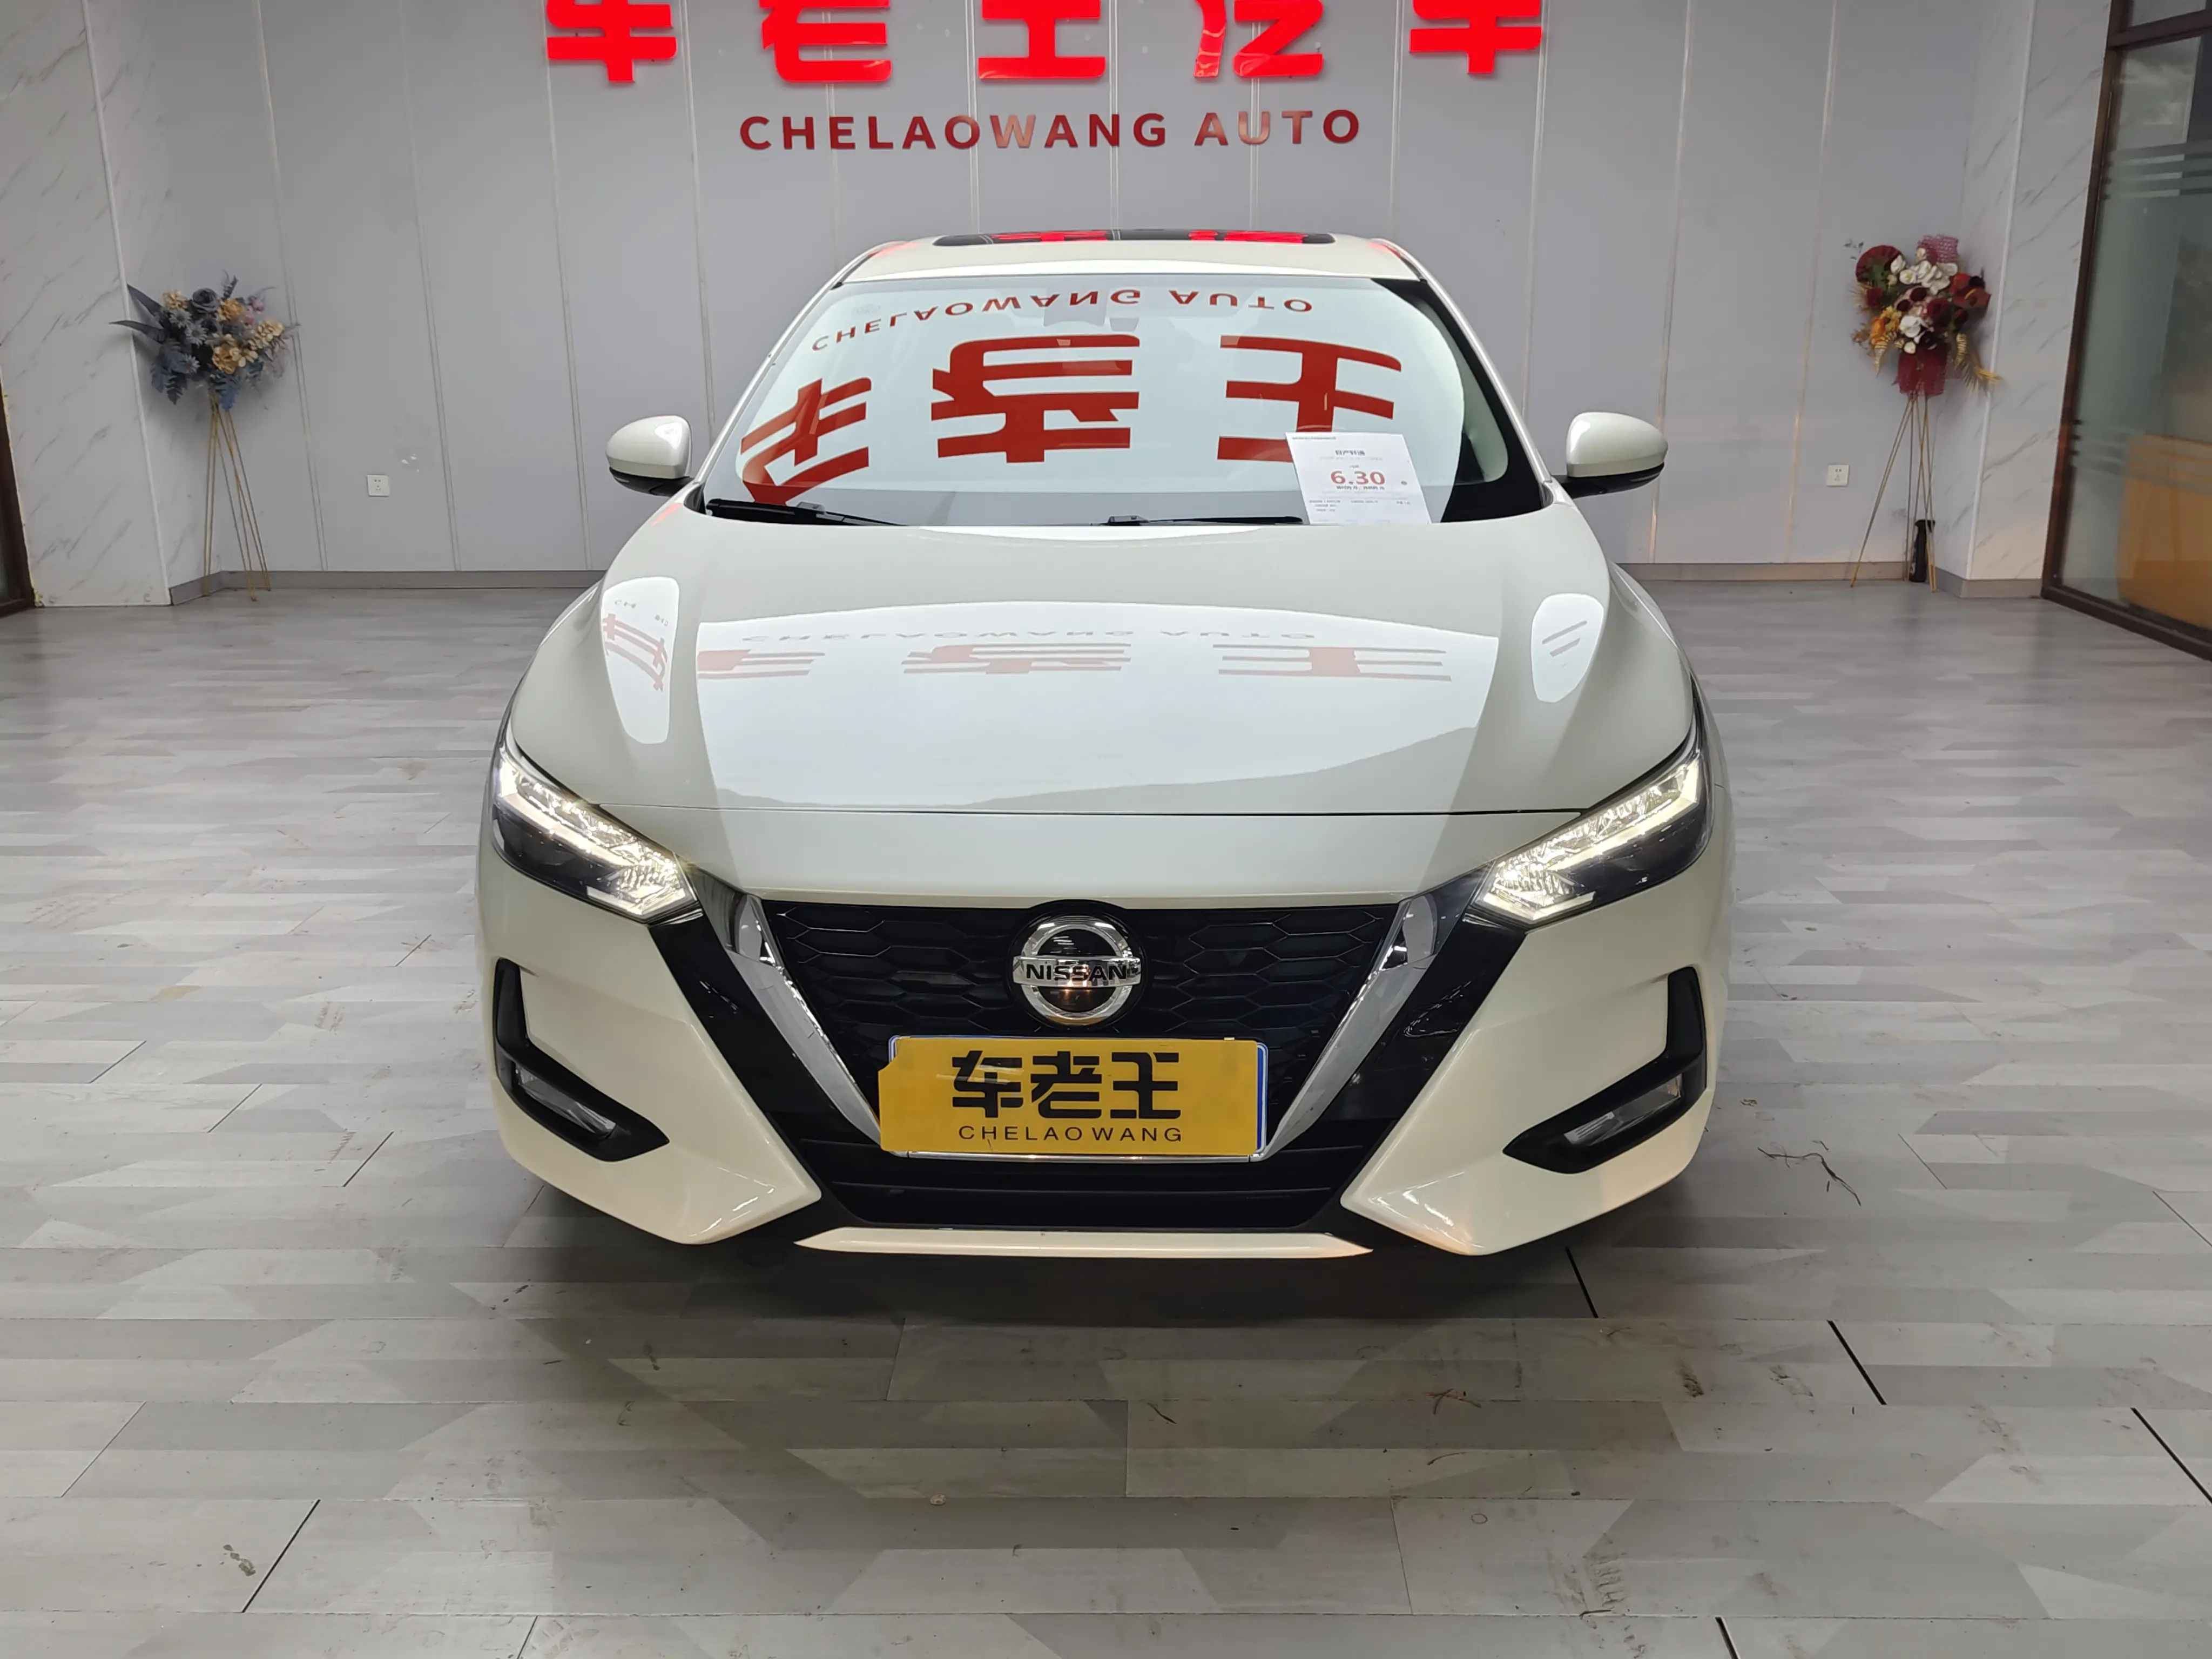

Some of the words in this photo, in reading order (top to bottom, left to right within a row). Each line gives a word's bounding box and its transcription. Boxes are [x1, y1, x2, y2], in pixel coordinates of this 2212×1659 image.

[740, 112, 1166, 150] CHELAOWANG
[1193, 109, 1359, 146] AUTO
[1330, 470, 1386, 485] 6.30
[1026, 964, 1127, 982] NISSAN
[952, 1050, 1182, 1119] 车老王
[958, 1125, 1182, 1142] CHELAOWANG
